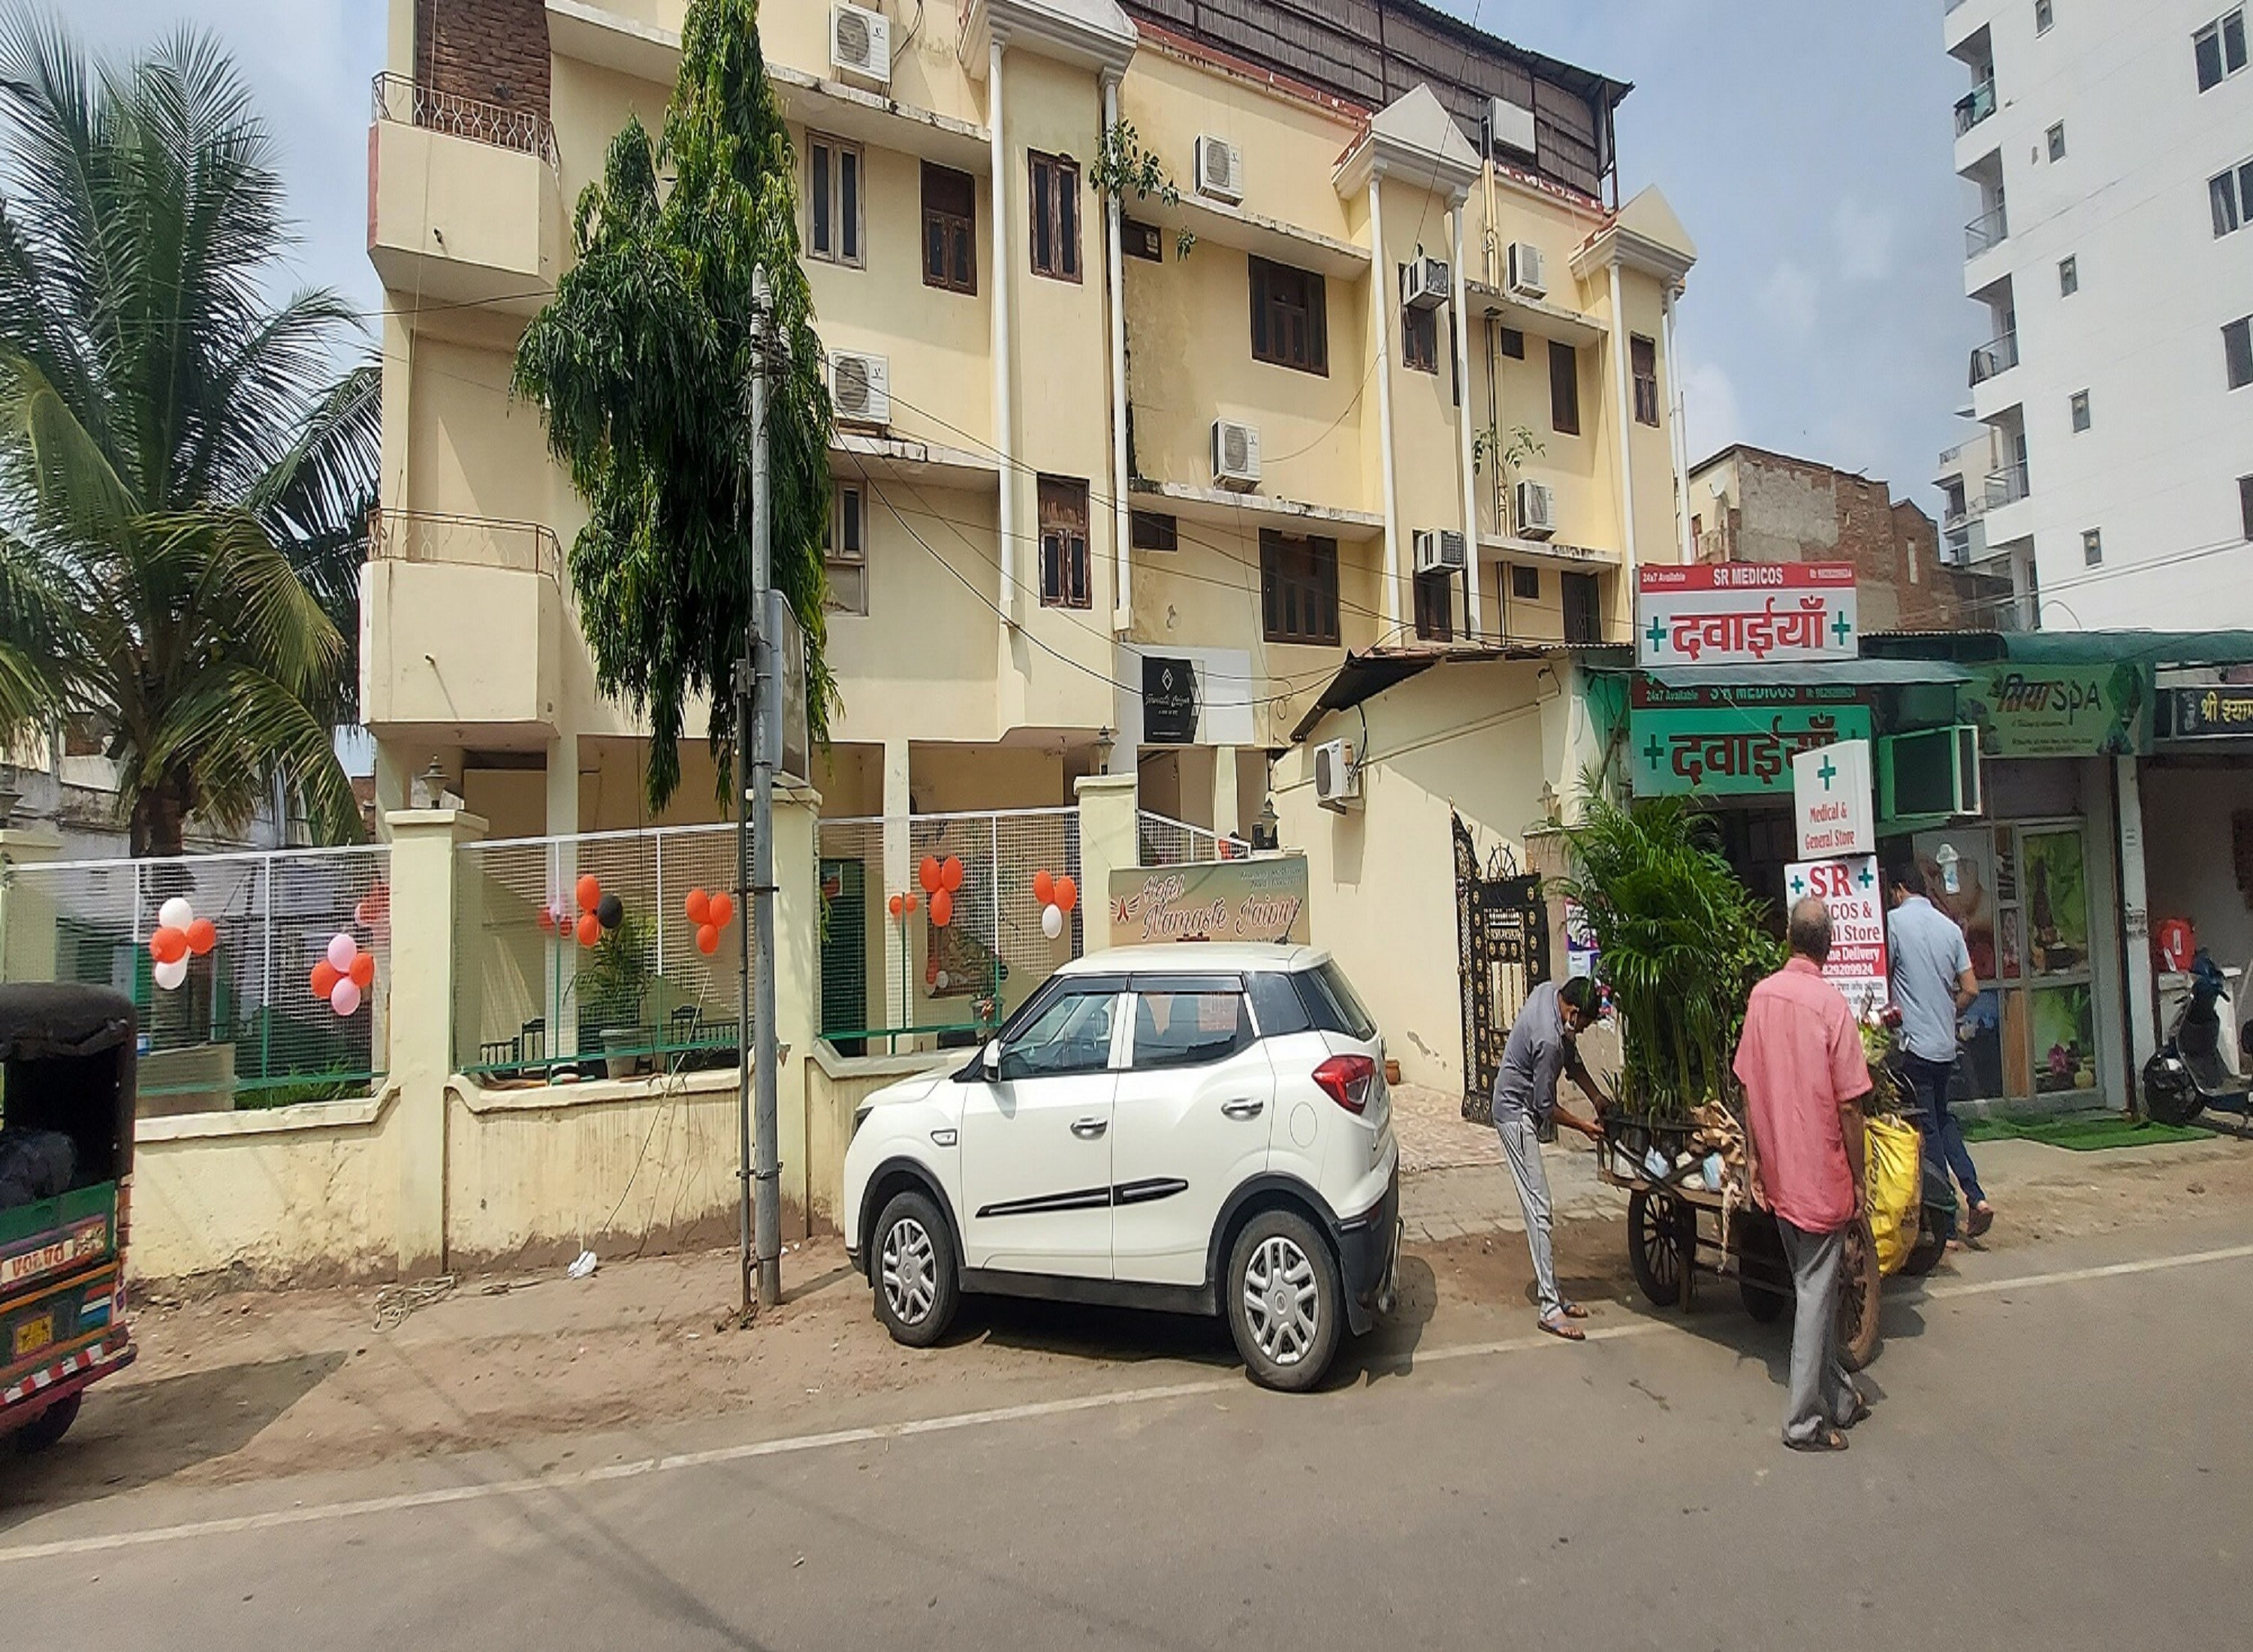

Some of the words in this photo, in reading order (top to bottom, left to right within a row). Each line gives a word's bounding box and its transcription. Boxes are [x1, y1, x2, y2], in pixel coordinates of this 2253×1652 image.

[1713, 568, 1729, 586] SR
[1732, 567, 1784, 585] MEDICOS
[1669, 595, 1827, 661] दवाईयाँ
[2201, 692, 2218, 722] श्री
[1810, 802, 1838, 824] Medical
[1841, 802, 1847, 818] &
[1805, 829, 1832, 851] General
[1835, 829, 1854, 846] Store
[1143, 873, 1184, 903] Hotel
[1810, 864, 1852, 900] SR
[1142, 897, 1229, 940] Namaste
[1235, 893, 1301, 936] Jaipur
[1862, 901, 1872, 918] &
[1844, 924, 1880, 942] Store
[1842, 945, 1880, 963] Delivery
[1822, 963, 1874, 975] 829209924
